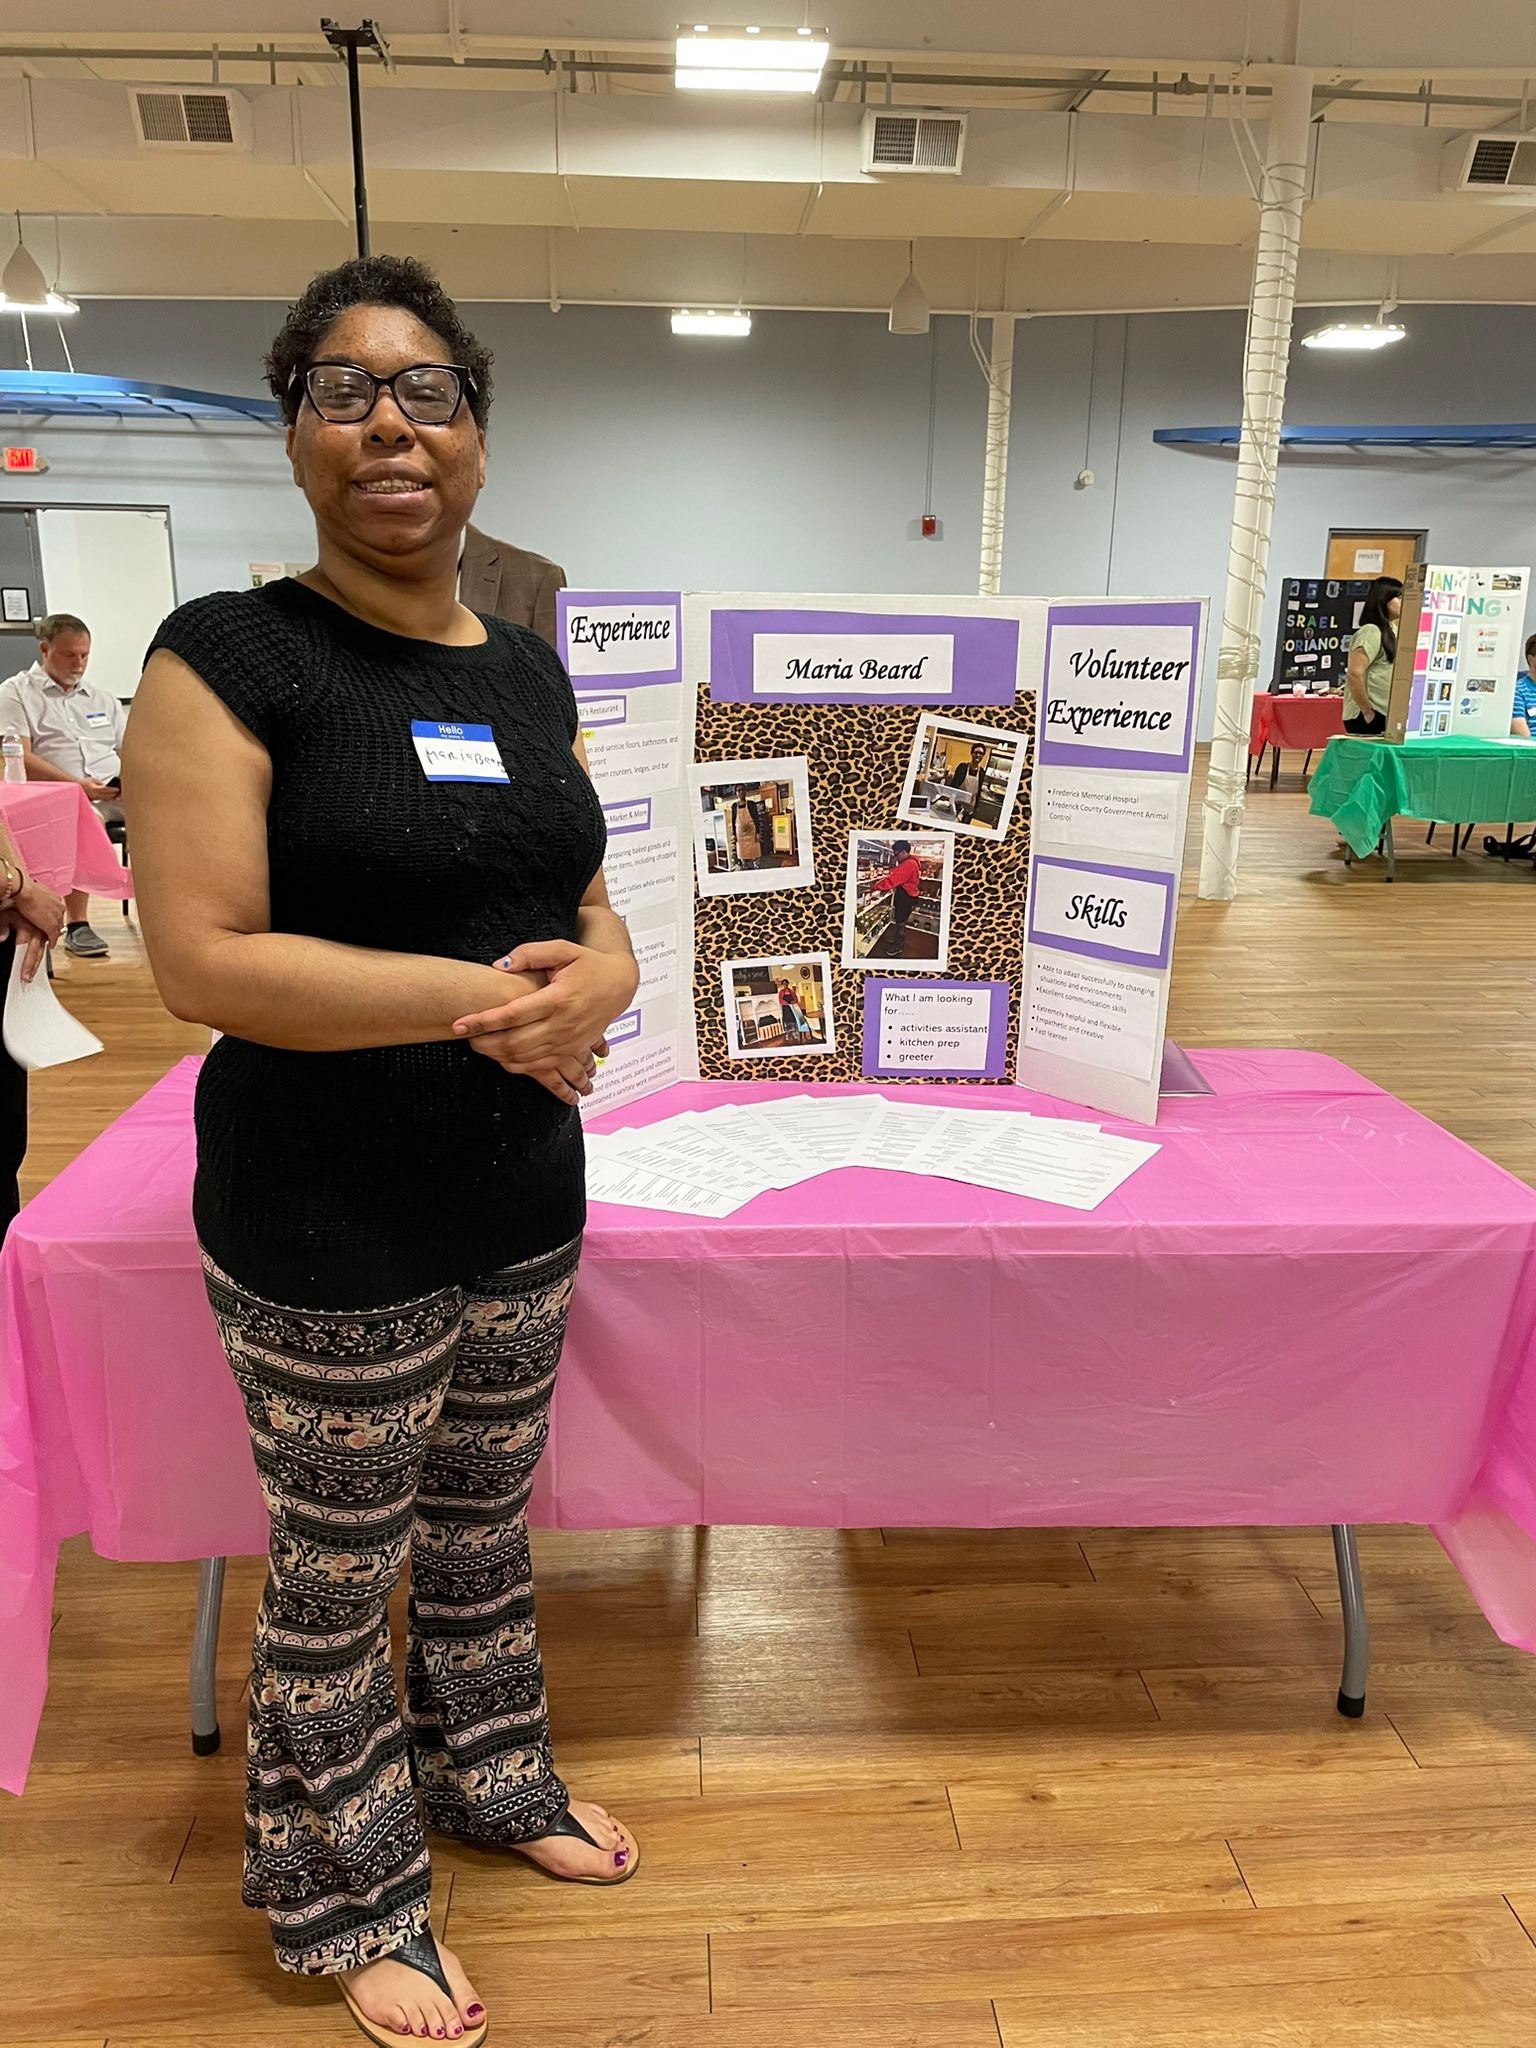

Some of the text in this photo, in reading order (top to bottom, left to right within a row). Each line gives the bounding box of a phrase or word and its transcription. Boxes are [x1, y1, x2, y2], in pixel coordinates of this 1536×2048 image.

[570, 613, 671, 652] Experience
[785, 656, 929, 680] Maria Beard
[1069, 648, 1190, 681] Volunteer
[590, 705, 619, 714] Restaurant
[1047, 699, 1172, 735] Experience
[437, 724, 464, 735] Hello
[594, 771, 609, 780] down
[1052, 788, 1139, 804] Frederick Memorial Hospital
[609, 814, 628, 822] Market
[1049, 813, 1072, 822] Control
[1051, 801, 1169, 820] Frederick County Government Animal
[608, 848, 632, 860] preparing
[647, 842, 661, 852] goods
[1065, 894, 1128, 929] Skills
[1040, 975, 1122, 1000] situations and environments
[1042, 964, 1155, 997] Able to adapt successfully to changing
[885, 993, 910, 1002] What
[912, 993, 916, 1002] I
[937, 994, 973, 1006] looking
[1039, 986, 1127, 1014] Excellent communication skills
[1036, 1004, 1122, 1032] Extremely helpful and flexible
[900, 1024, 988, 1034] activities assistant
[1034, 1027, 1068, 1042] Fast learner
[1036, 1015, 1104, 1040] Empathetic and creative
[899, 1038, 960, 1048] kitchen prep
[899, 1053, 934, 1062] greeter
[635, 1078, 648, 1087] work
